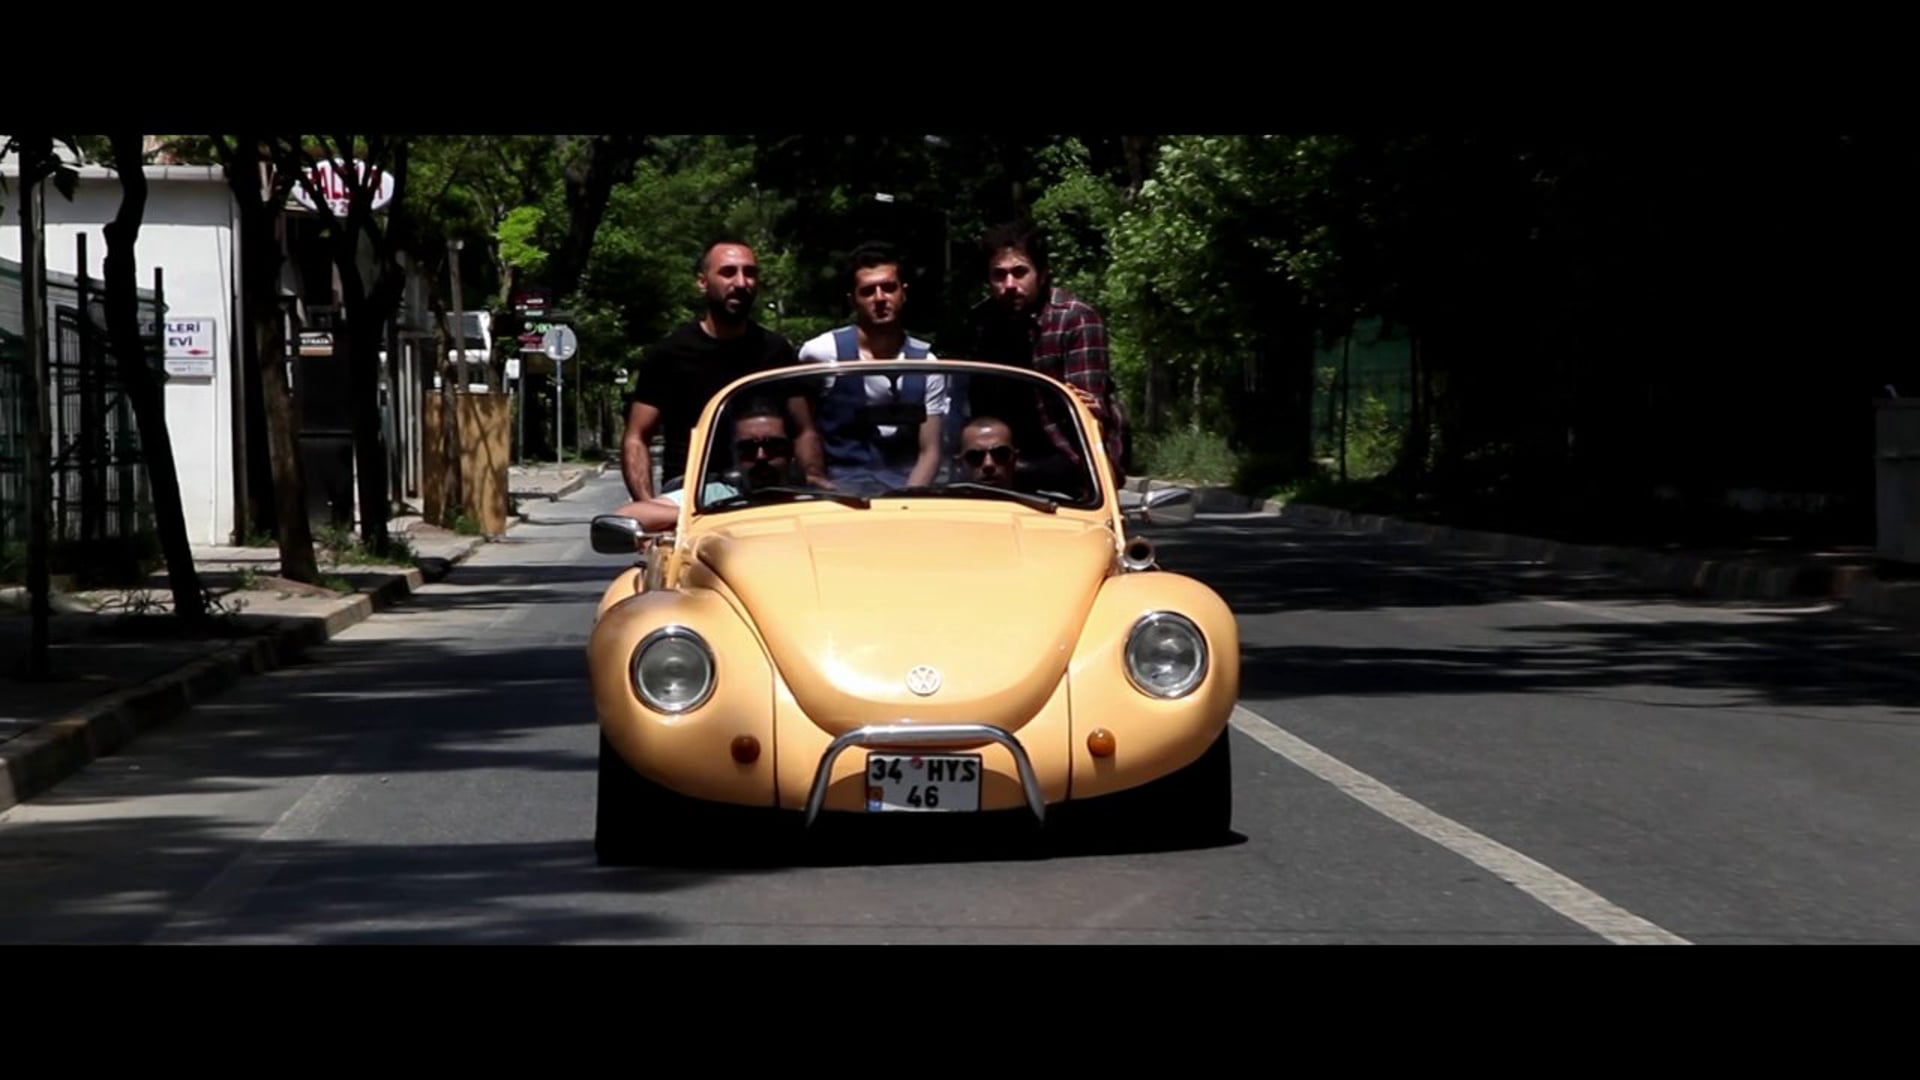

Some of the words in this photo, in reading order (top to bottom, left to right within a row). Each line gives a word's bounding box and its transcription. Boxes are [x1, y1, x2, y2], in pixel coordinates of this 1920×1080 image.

[871, 757, 903, 784] 34
[926, 758, 977, 783] HYS
[906, 785, 940, 808] 46
